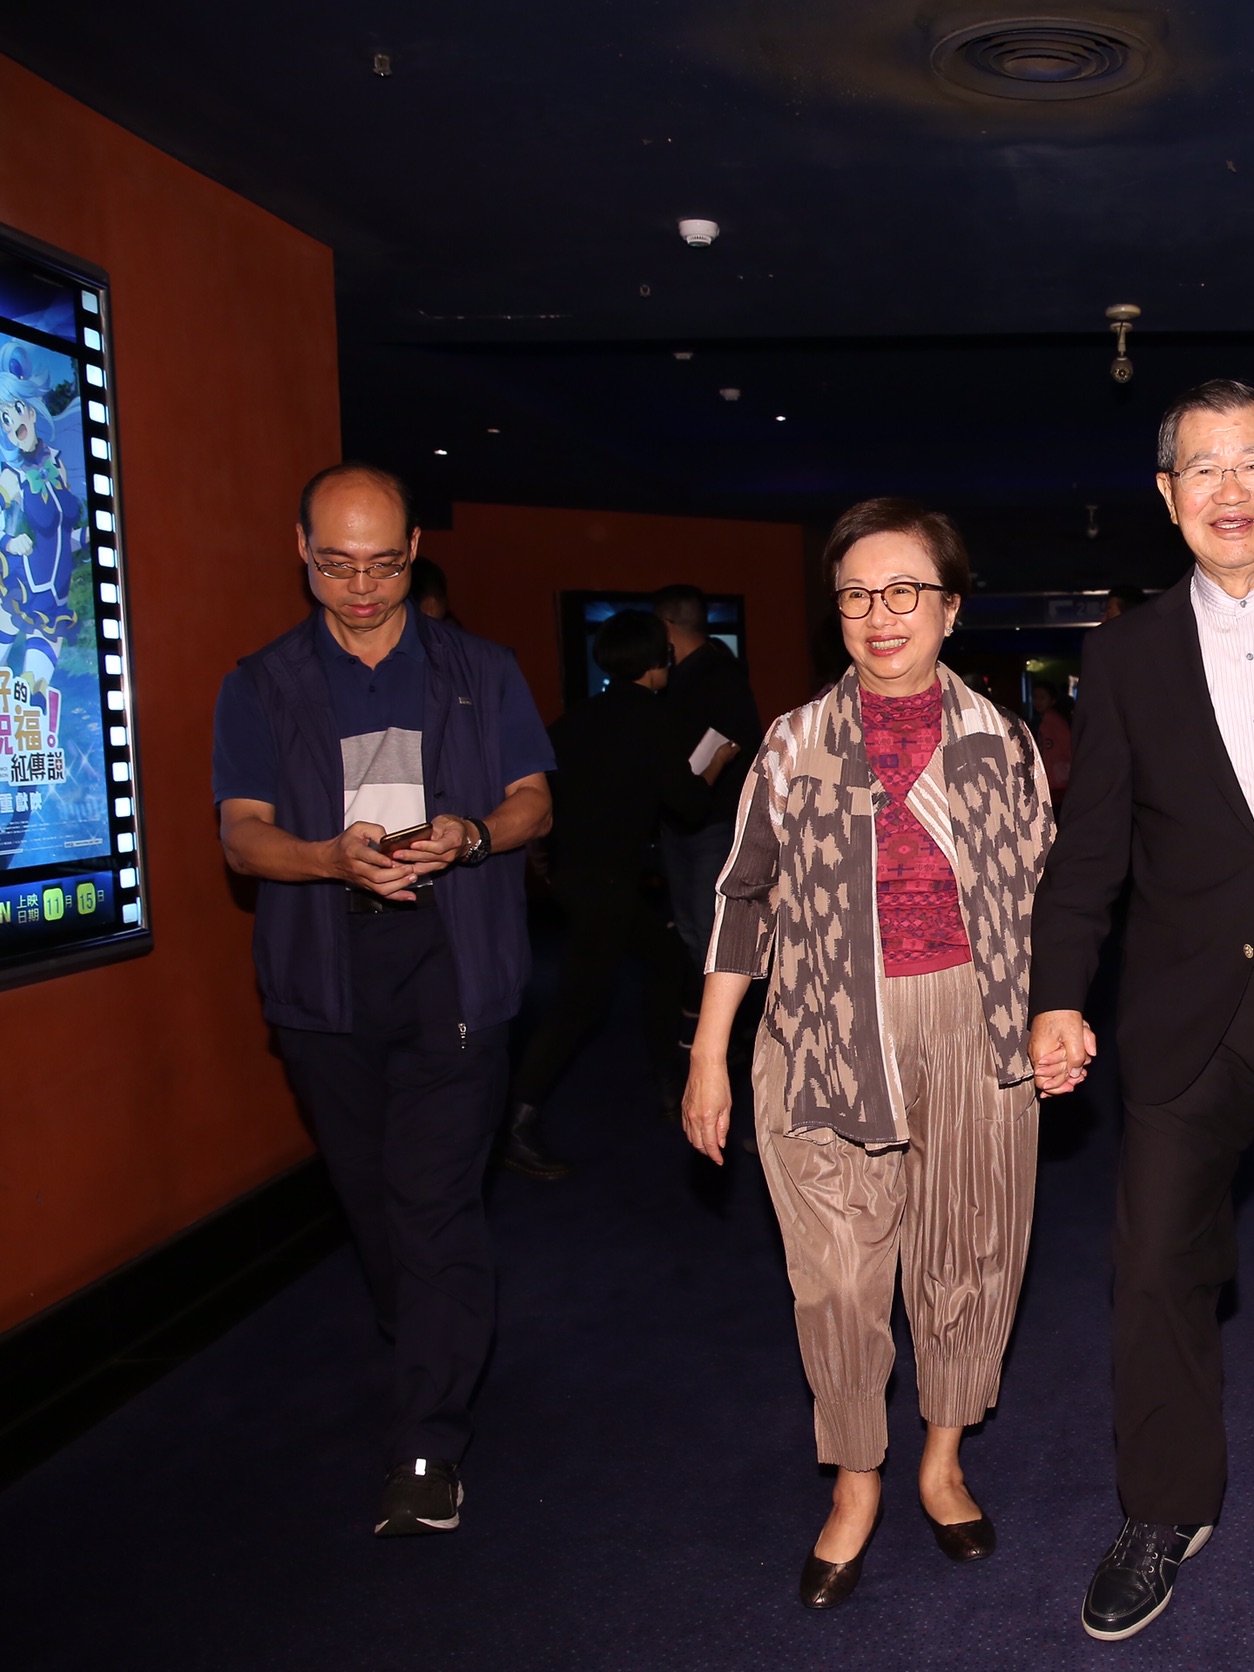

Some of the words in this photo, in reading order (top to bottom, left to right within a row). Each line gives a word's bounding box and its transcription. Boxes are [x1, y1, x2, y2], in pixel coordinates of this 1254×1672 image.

[17, 894, 39, 909] 上映
[65, 894, 73, 909] 月
[79, 892, 94, 912] 15
[97, 889, 105, 903] 日
[18, 908, 39, 924] 日期
